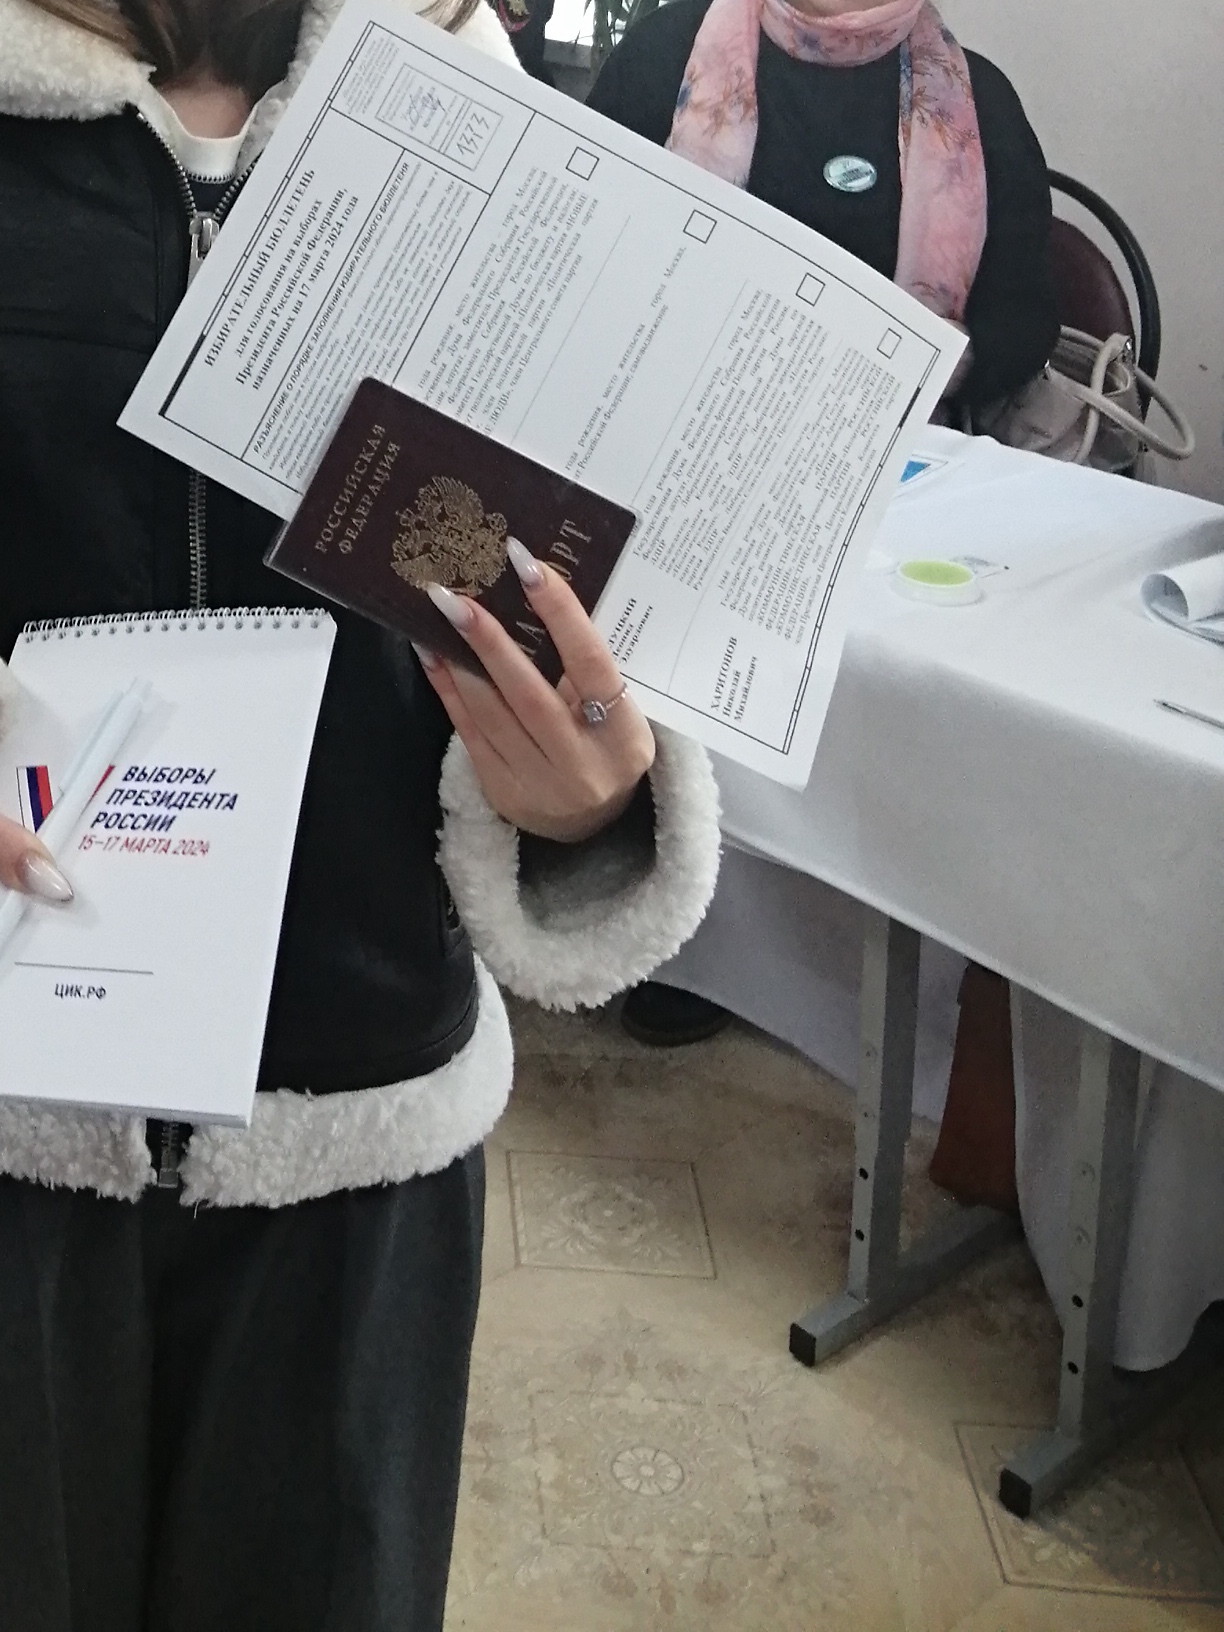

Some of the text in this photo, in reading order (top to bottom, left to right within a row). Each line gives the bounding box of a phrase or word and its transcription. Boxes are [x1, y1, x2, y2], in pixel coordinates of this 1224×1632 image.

[202, 166, 316, 367] ИЗБИРАТЕЛЬНЫЙ БЮЛЛЕТЕНЬ
[233, 334, 252, 359] для
[245, 263, 288, 335] голосования
[291, 197, 324, 248] выборах
[234, 316, 278, 386] Президента
[269, 250, 311, 318] Российской
[304, 184, 348, 253] Федерации,
[309, 287, 344, 344] ЗАПОЛНЕНИЯ
[338, 212, 384, 289] ИЗБИРАТЕЛЬНОГО
[377, 161, 410, 214] БЮЛЛЕТЕНЯ
[251, 314, 295, 391] назначенных
[307, 248, 332, 284] марта
[323, 219, 345, 248] 2024
[340, 195, 360, 222] года
[315, 423, 386, 554] РОССИЙСКАЯ
[338, 441, 401, 555] ФЕДЕРАЦИЯ
[605, 596, 637, 649] ЛУЦКИЙ
[709, 635, 738, 711] ХАРИТОНОВ
[721, 668, 741, 717] Николай
[733, 654, 758, 723] Михайлович
[106, 788, 239, 811] ПРЕЗИДЕНТА
[122, 765, 216, 786] ВЫБОРЫ
[90, 811, 178, 833] РОССИИ
[120, 836, 172, 855] МАРТА
[173, 839, 211, 857] 2024
[54, 983, 107, 1000] ЦИК.РФ
